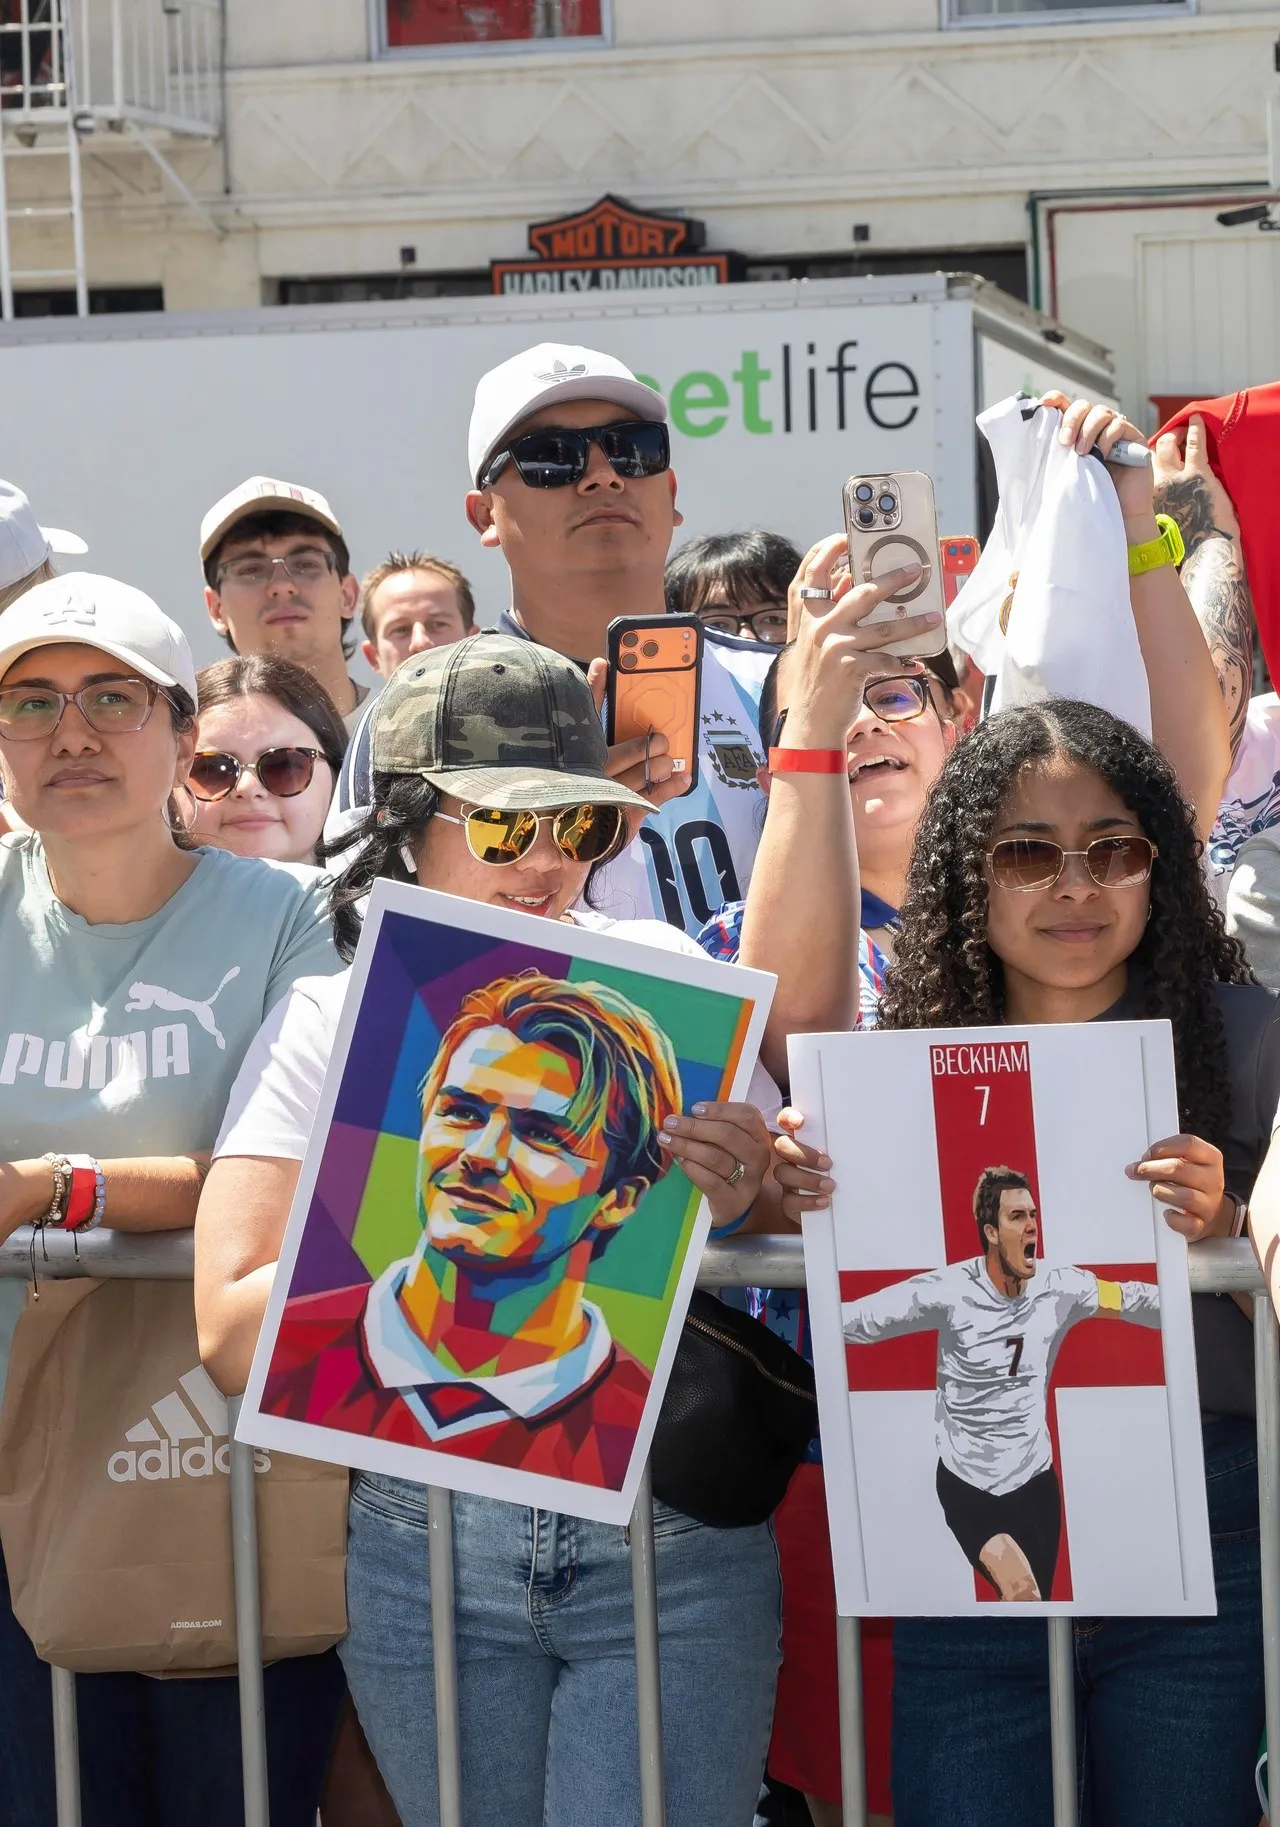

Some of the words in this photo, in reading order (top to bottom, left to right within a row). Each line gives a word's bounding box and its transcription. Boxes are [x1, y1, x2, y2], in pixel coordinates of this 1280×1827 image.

[552, 215, 665, 257] MOTOR
[634, 340, 919, 438] etlife
[639, 820, 742, 931] 10
[0, 1023, 190, 1090] PUMA
[932, 1045, 1028, 1075] BECKHAM
[974, 1085, 991, 1125] 7
[1005, 1336, 1024, 1376] 7
[170, 1619, 223, 1629] ADIDAS.COM
